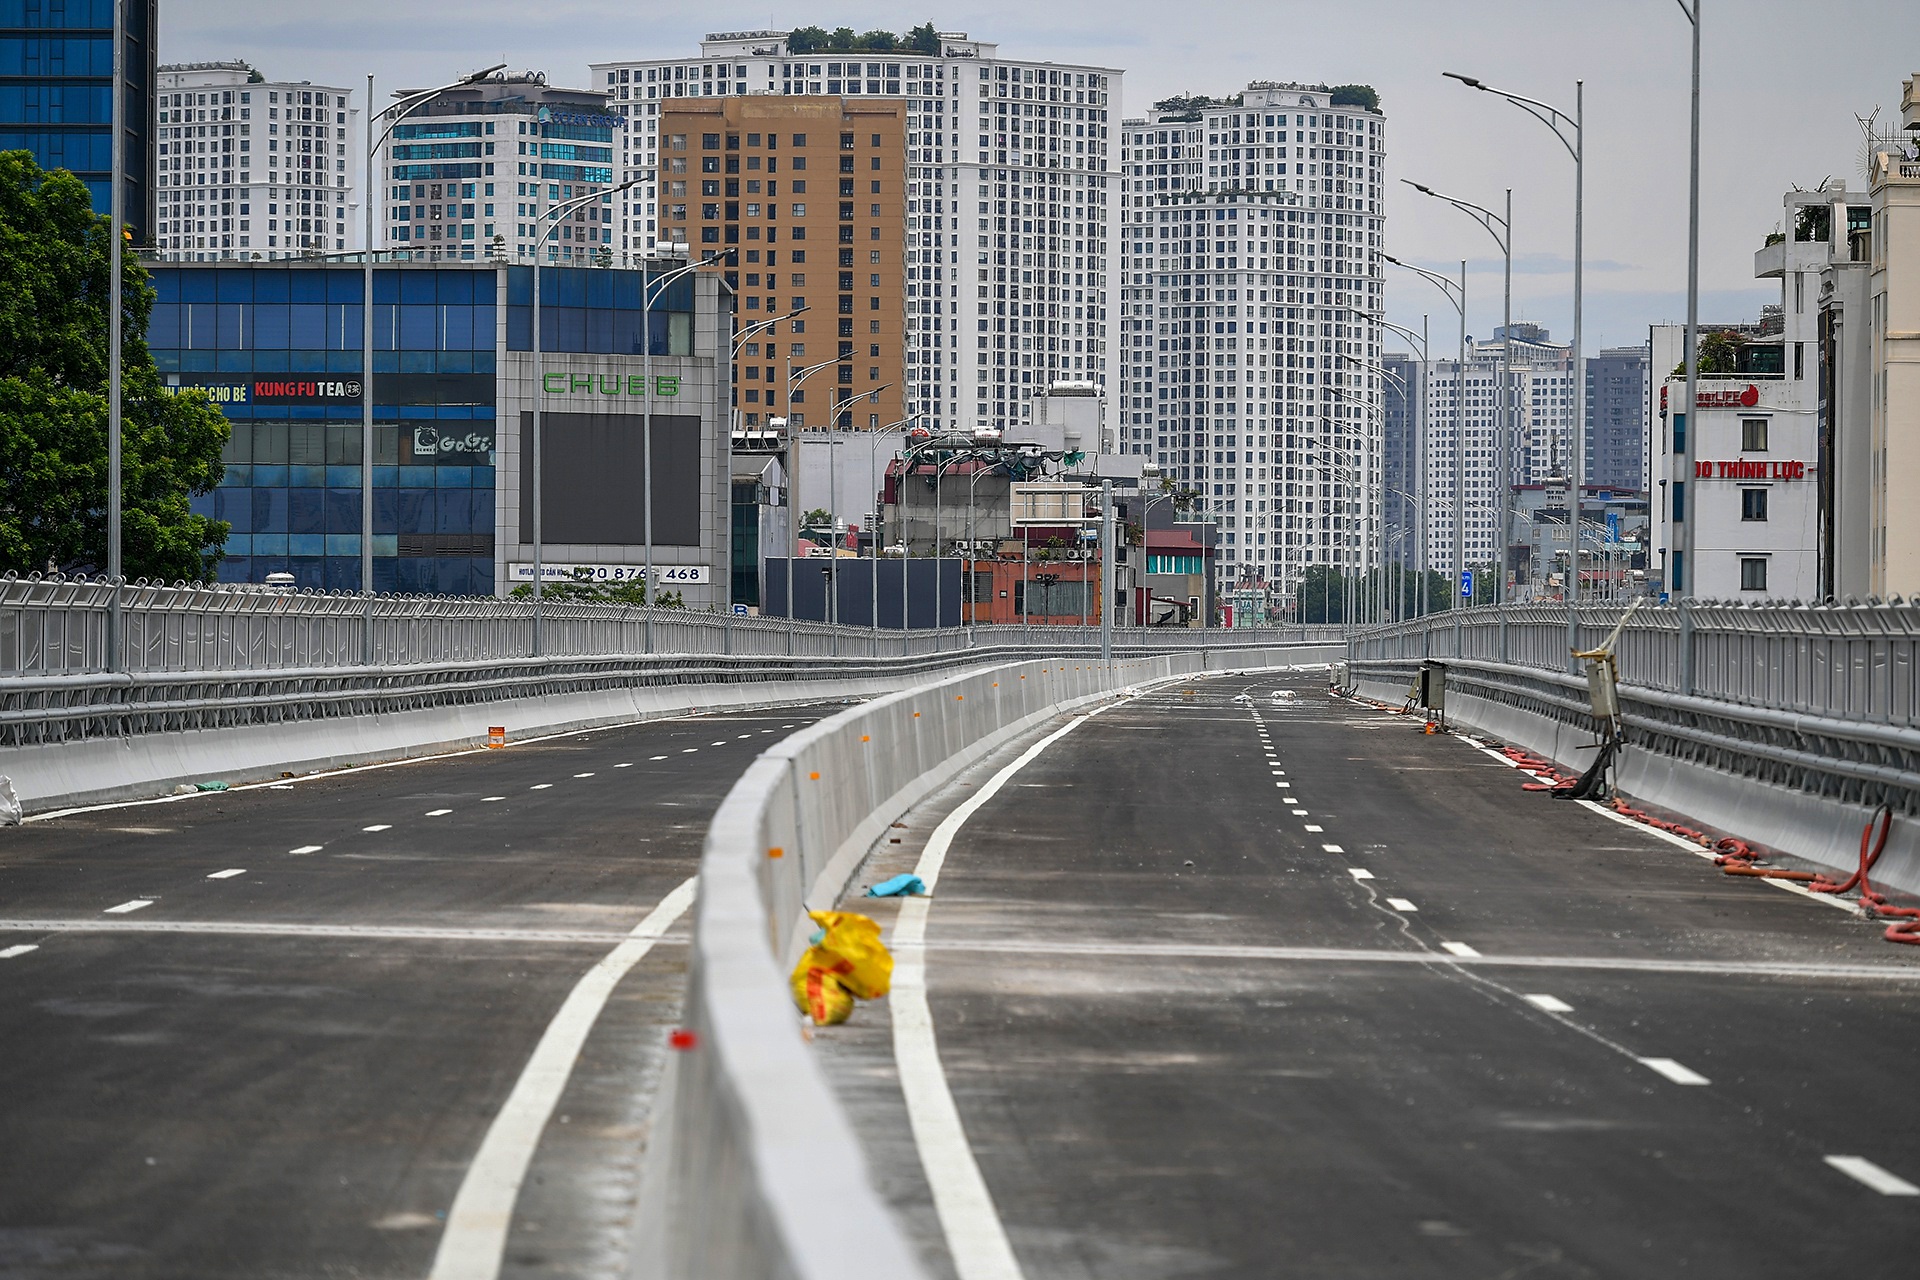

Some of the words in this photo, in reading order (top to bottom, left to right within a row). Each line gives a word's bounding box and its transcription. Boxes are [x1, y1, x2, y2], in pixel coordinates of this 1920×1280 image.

[553, 111, 587, 125] OCEAN
[590, 113, 625, 127] GROUP
[255, 381, 296, 397] KUNG
[297, 381, 316, 397] FU
[317, 381, 345, 397] TEA
[544, 373, 679, 395] CHUBB
[209, 386, 231, 402] CHO
[233, 383, 247, 402] BÉ
[1695, 391, 1741, 401] earLIFE
[1718, 458, 1767, 479] THÍNH
[1773, 460, 1804, 482] LỰC
[666, 568, 700, 580] 468
[1461, 581, 1469, 593] 4
